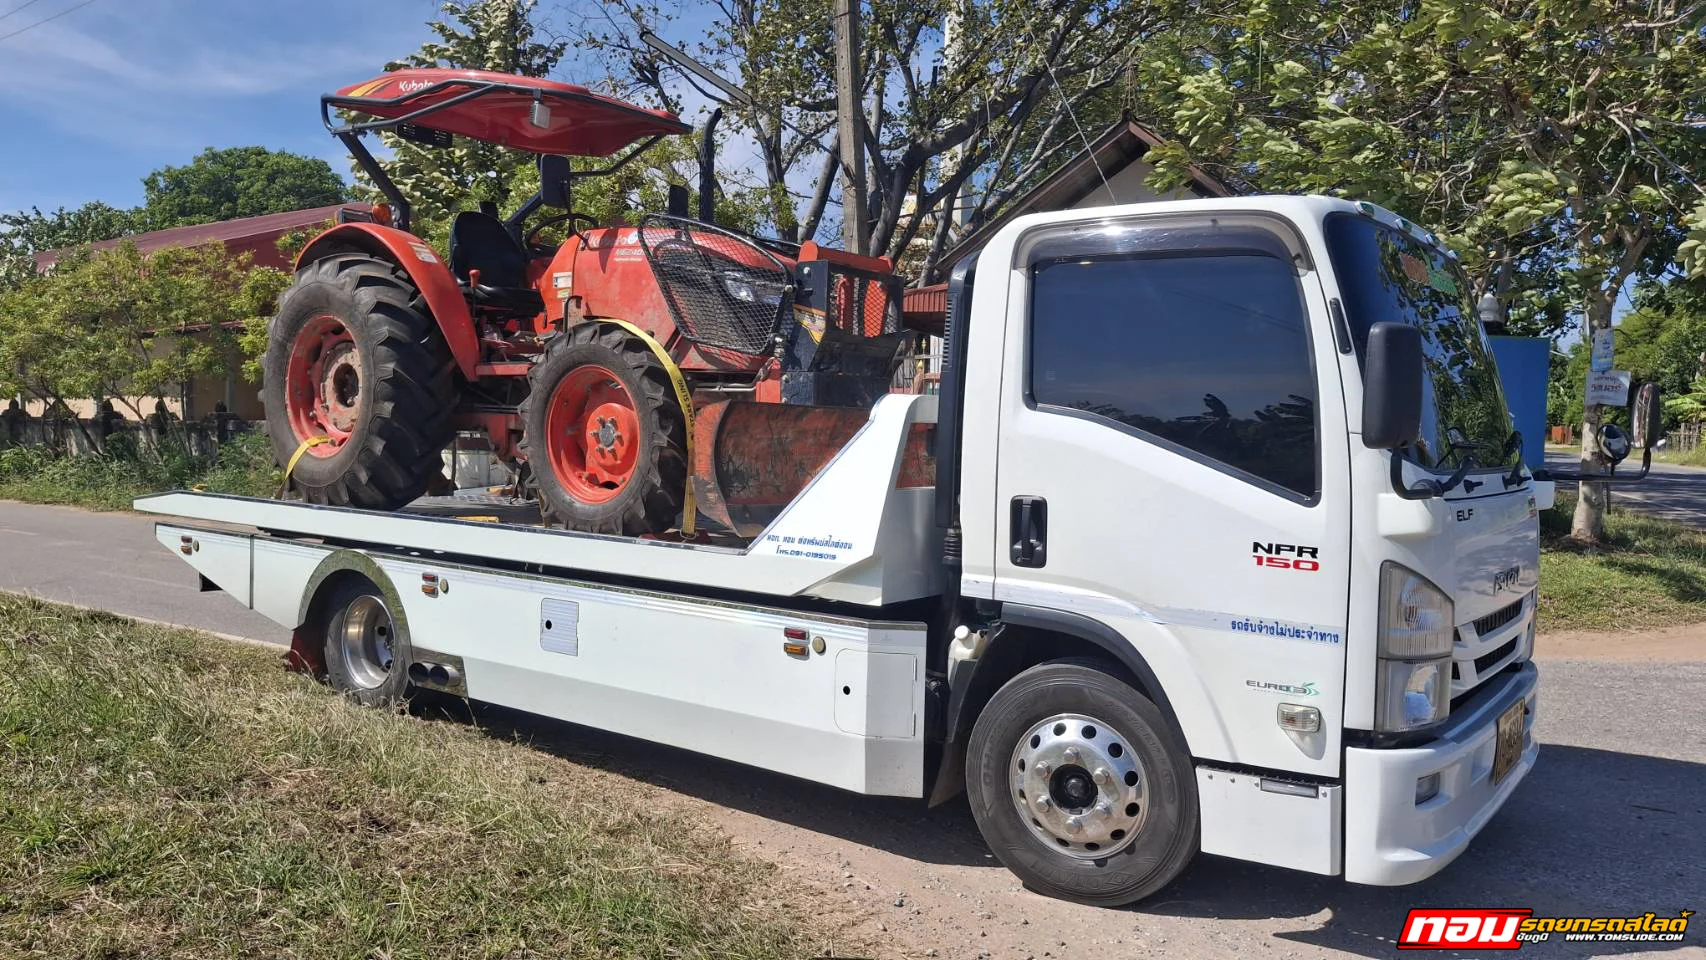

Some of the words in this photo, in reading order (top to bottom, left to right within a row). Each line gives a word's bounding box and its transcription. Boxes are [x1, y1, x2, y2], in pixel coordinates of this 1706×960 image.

[1456, 509, 1474, 521] ELF
[1252, 541, 1319, 559] NPR
[1252, 555, 1320, 572] 150
[1231, 618, 1339, 643] รถรับจ้างไม่ประจำทาง
